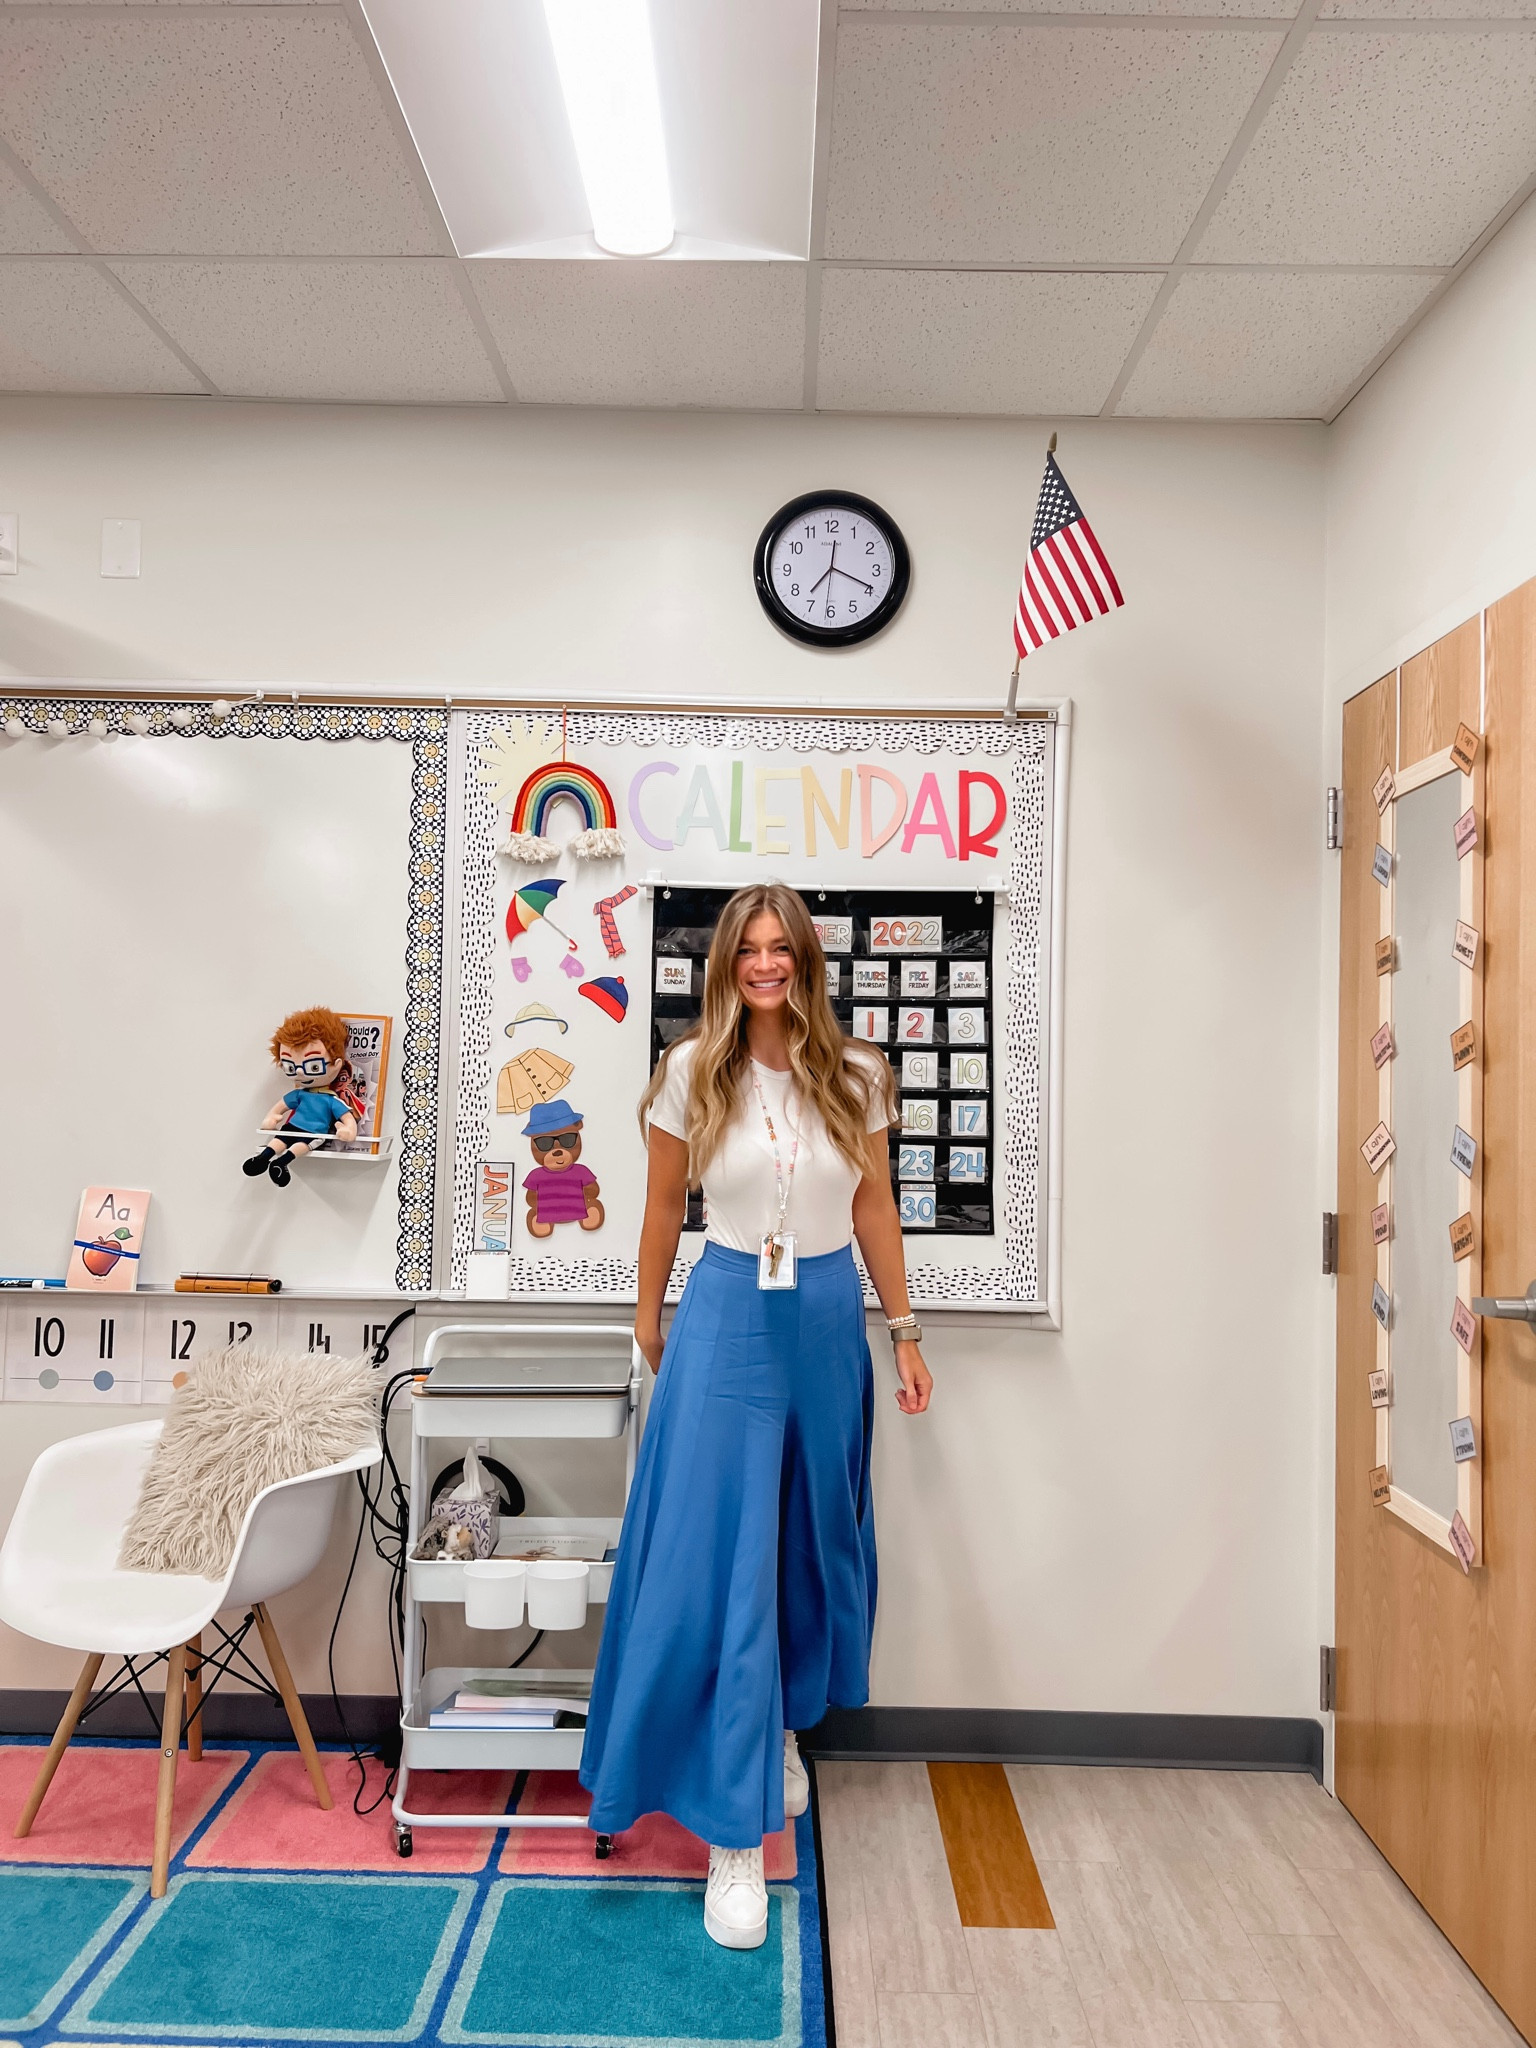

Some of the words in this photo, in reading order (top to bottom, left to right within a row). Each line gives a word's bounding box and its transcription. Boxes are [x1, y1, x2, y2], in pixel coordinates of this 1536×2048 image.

[804, 526, 816, 539] 11
[824, 520, 839, 533] 12
[851, 526, 856, 539] 1
[789, 541, 803, 555] 10
[865, 541, 875, 555] 2
[783, 564, 792, 577] 9
[872, 564, 881, 577] 3
[791, 583, 800, 597] 8
[864, 584, 874, 597] 4
[806, 600, 816, 612] 7
[826, 605, 836, 618] 6
[848, 600, 858, 613] 5
[628, 761, 1007, 860] CALENDAR
[873, 921, 940, 946] 2022
[1455, 941, 1474, 960] HONEST
[957, 971, 978, 982] SAT.
[867, 1011, 875, 1037] 1
[907, 1012, 925, 1038] 2
[958, 1013, 976, 1038] 3
[1454, 1042, 1475, 1064] FUNNY
[909, 1057, 928, 1083] 9
[957, 1058, 983, 1084] 10
[906, 1104, 933, 1131] 16
[958, 1105, 982, 1132] 17
[899, 1150, 935, 1176] 23
[949, 1152, 985, 1177] 24
[1457, 1151, 1472, 1170] FRIEND
[96, 1194, 131, 1221] Aa
[900, 1196, 935, 1222] 30
[1375, 1224, 1387, 1237] PROUD
[1453, 1232, 1473, 1253] BRIGHT
[1373, 1298, 1386, 1322] KIND
[34, 1317, 65, 1358] 10
[99, 1319, 115, 1359] 11
[170, 1319, 197, 1360] 12
[1456, 1321, 1469, 1344] SAFE
[1372, 1388, 1388, 1400] LOVING
[1455, 1441, 1474, 1457] STRONG
